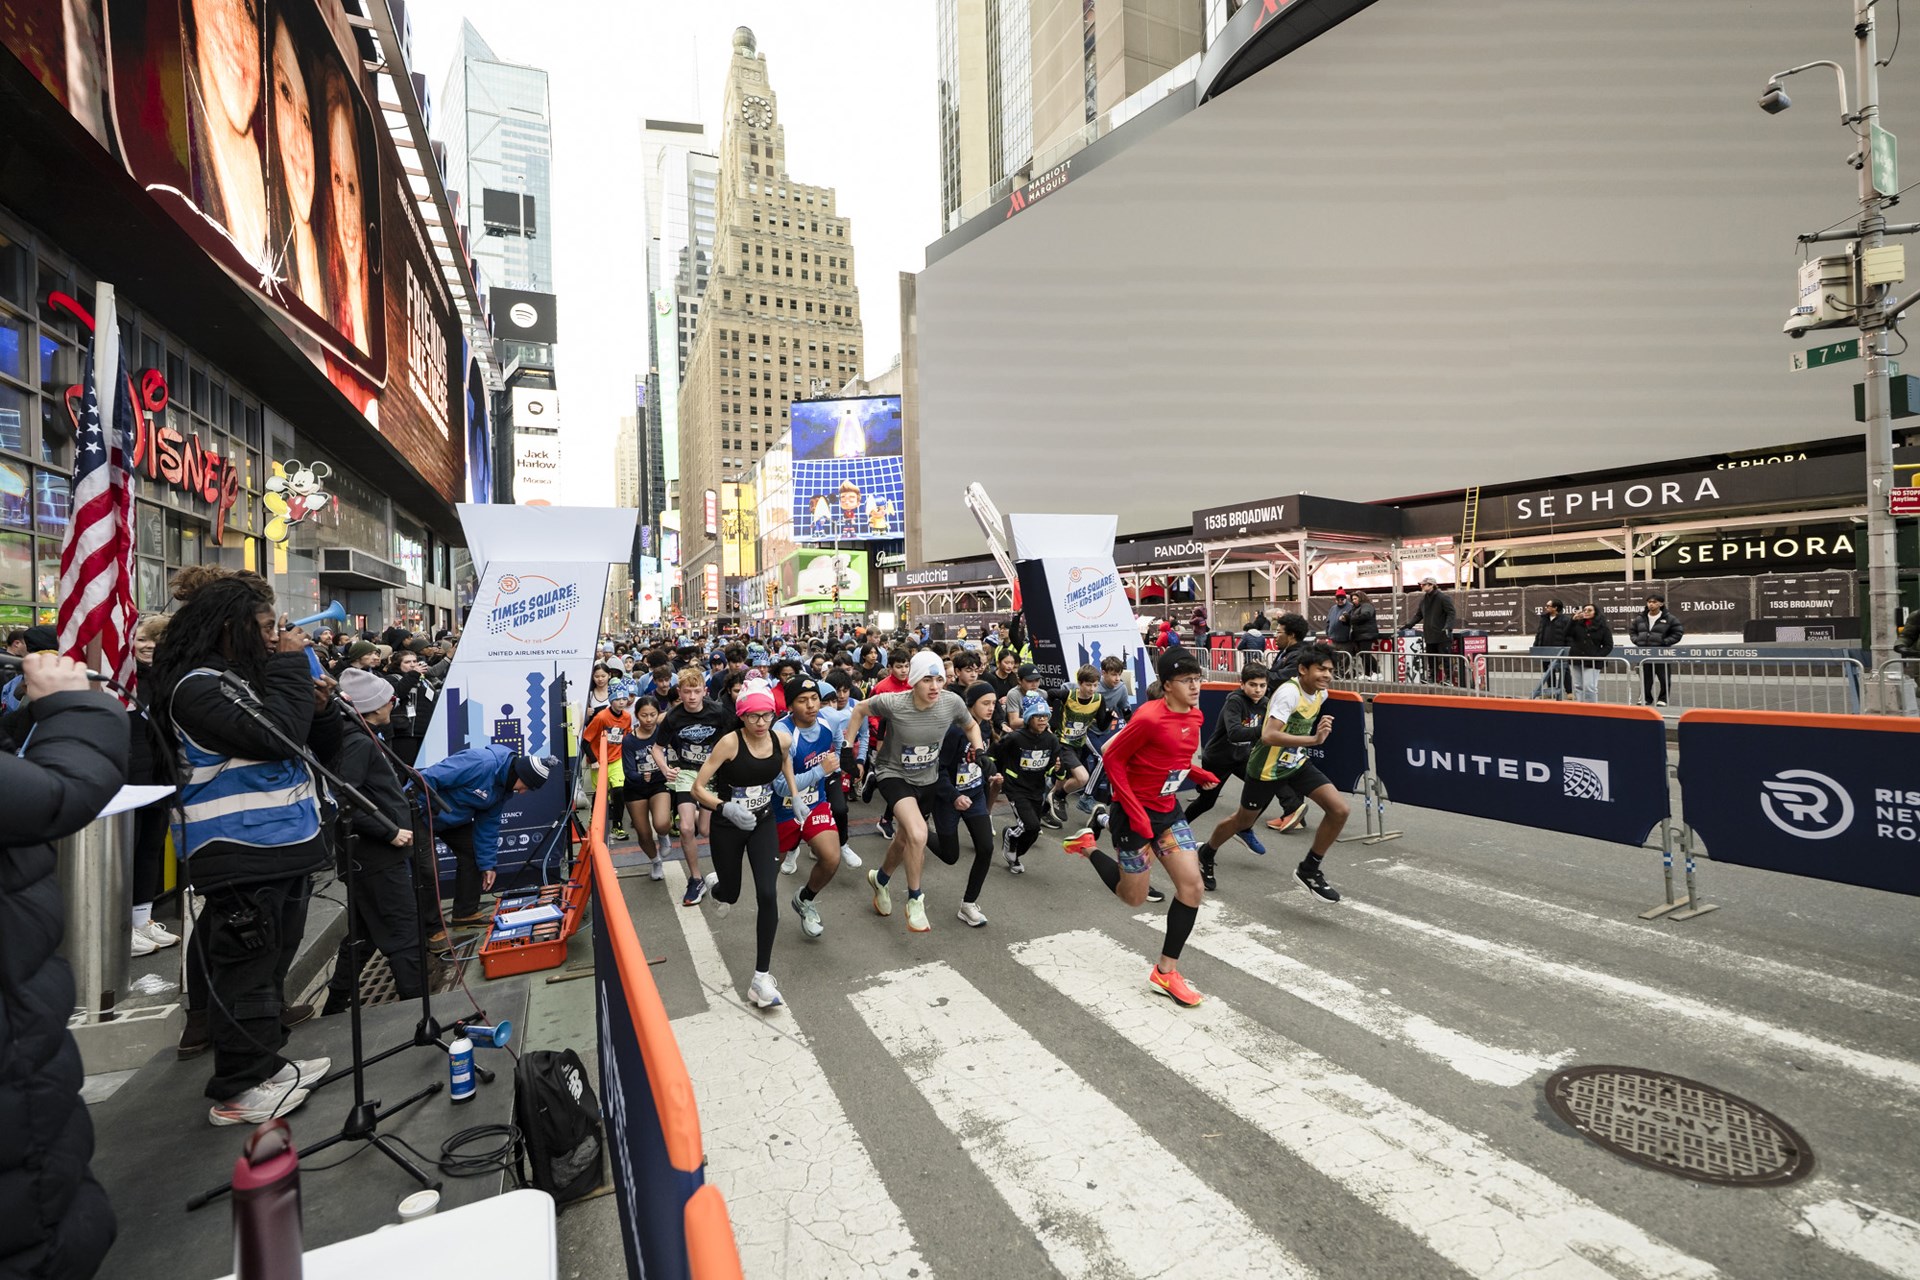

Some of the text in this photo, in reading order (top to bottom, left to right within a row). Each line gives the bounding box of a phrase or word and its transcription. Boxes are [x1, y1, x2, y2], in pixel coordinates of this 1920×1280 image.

[1028, 160, 1072, 192] MARRIOTT
[1028, 174, 1067, 202] MARQUIS
[1797, 305, 1814, 313] NYPD
[1819, 344, 1847, 363] 7 Av
[524, 449, 549, 459] Jack
[516, 459, 557, 470] Harlow
[1517, 477, 1720, 519] SEPHORA
[1204, 505, 1285, 530] 1535 BROADWAY
[1154, 540, 1204, 558] PANDOR
[1678, 535, 1854, 564] SEPHORA
[906, 569, 942, 584] swatch
[1066, 586, 1086, 603] TIMES
[1087, 574, 1112, 594] SQUARE
[491, 600, 526, 622] TIMES
[528, 584, 573, 610] SQUARE
[1079, 589, 1104, 608] KIDS RUN
[1790, 600, 1834, 608] BROADWAY
[1535, 606, 1543, 615] T
[1619, 605, 1645, 613] BROADW
[1681, 600, 1735, 611] T Mobile
[513, 604, 556, 628] KIDS RUN
[1726, 649, 1758, 657] CROSS
[1037, 664, 1062, 674] BELIEVE
[692, 753, 707, 761] 709
[903, 754, 933, 763] A 612
[1307, 748, 1325, 758] ERS
[1032, 759, 1045, 767] 607
[1405, 747, 1552, 784] UNITED
[958, 775, 965, 783] A
[1163, 783, 1171, 791] A
[785, 798, 792, 806] A
[1877, 823, 1920, 842] RO
[1620, 1101, 1720, 1135] WSNY
